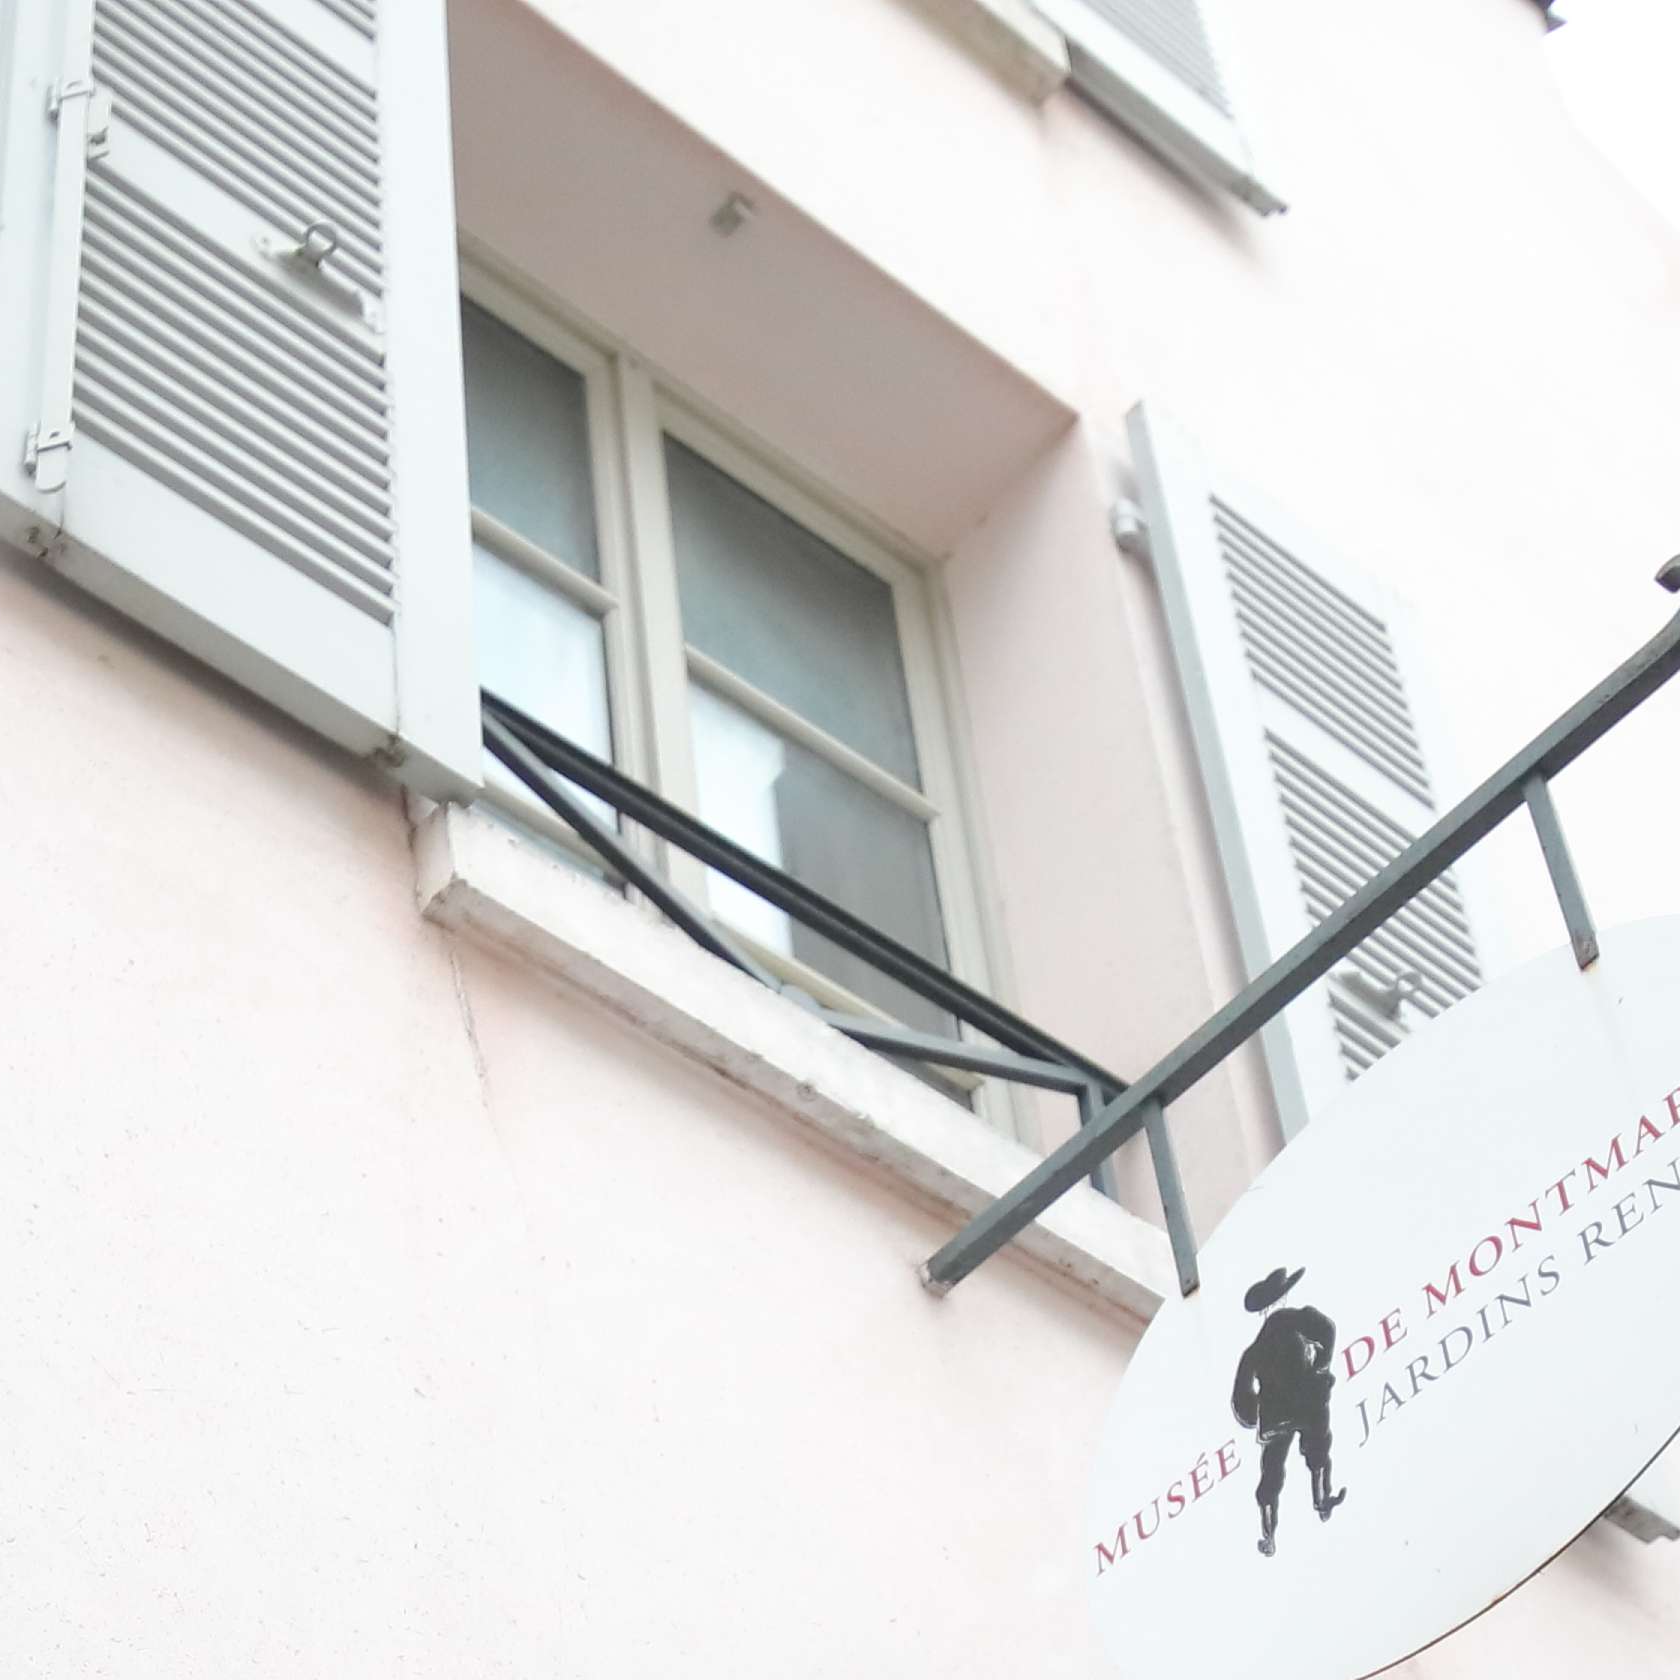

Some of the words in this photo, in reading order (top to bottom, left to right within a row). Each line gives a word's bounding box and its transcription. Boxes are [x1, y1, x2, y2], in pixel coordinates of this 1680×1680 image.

[1092, 1438, 1244, 1579] MUSÉE
[1340, 1308, 1409, 1383] DE
[1356, 1254, 1562, 1447] JARDINS
